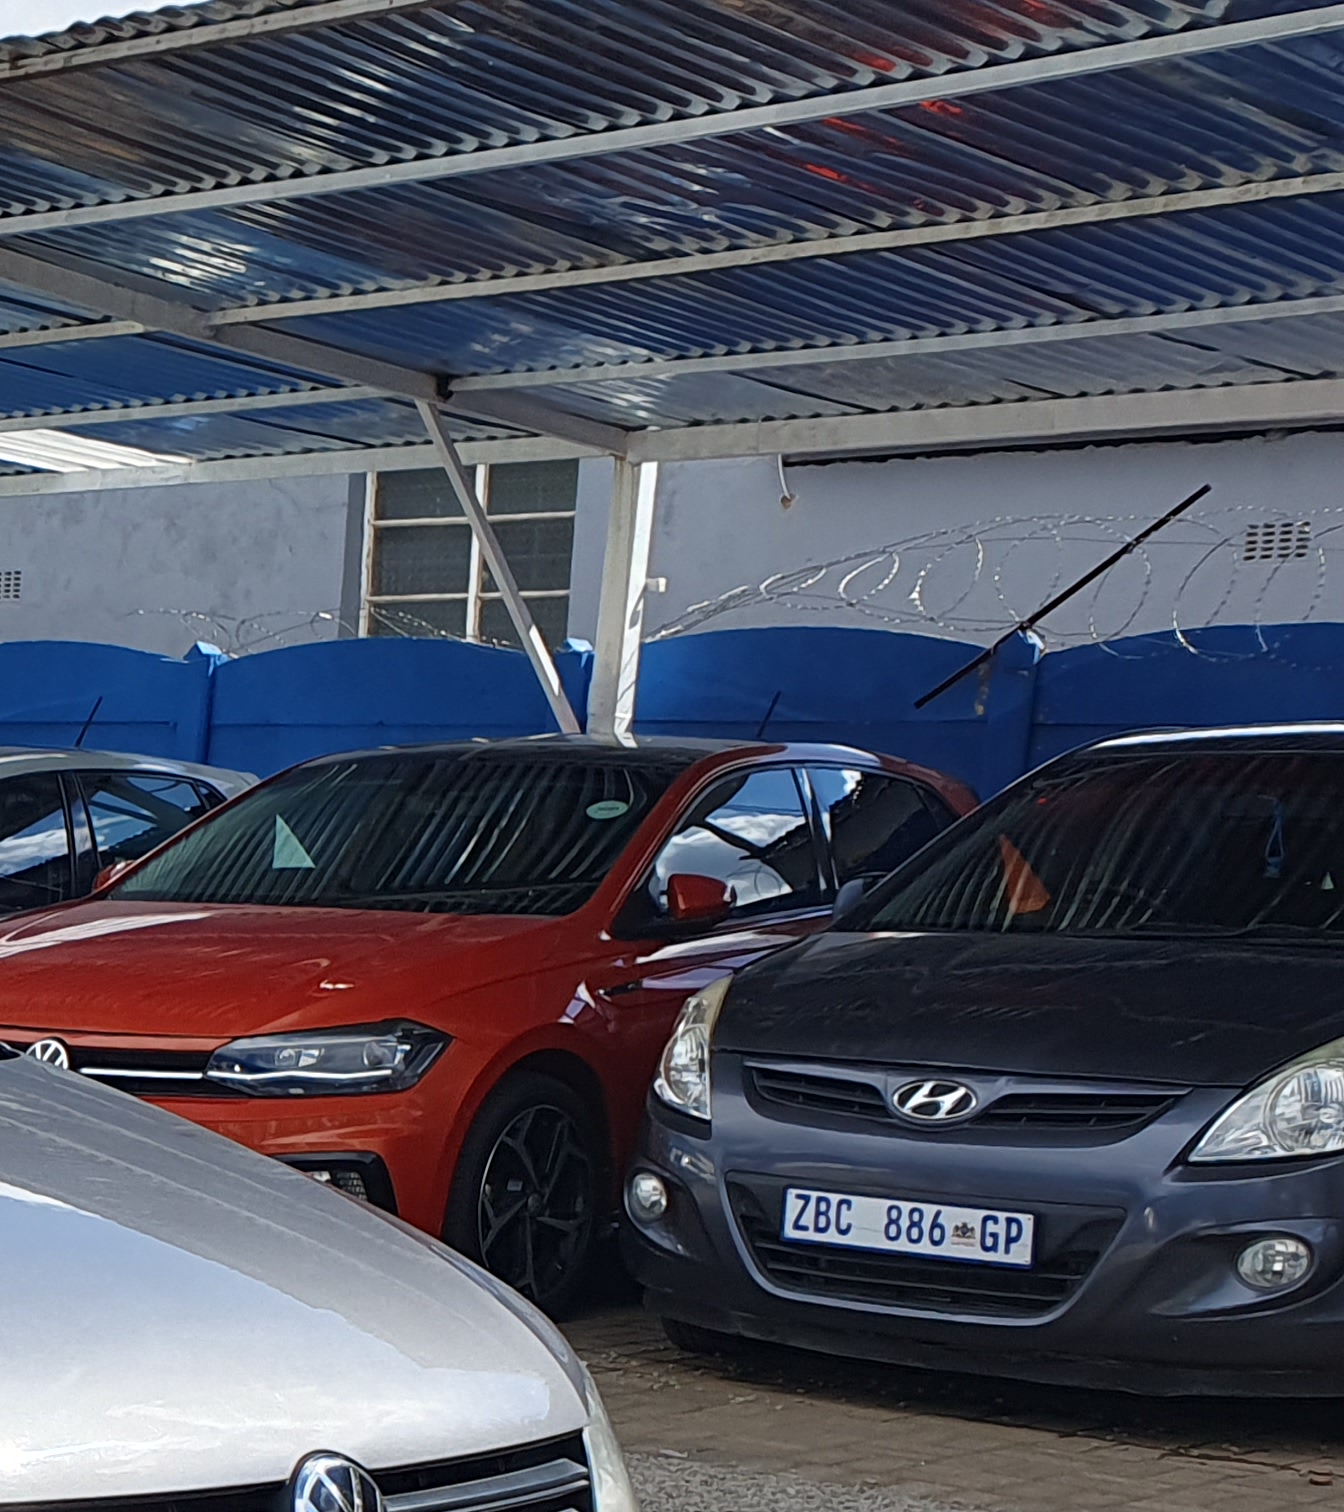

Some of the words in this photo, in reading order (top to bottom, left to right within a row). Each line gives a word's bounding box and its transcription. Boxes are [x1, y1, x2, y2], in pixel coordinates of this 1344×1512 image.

[791, 1193, 853, 1236] ZBC
[883, 1204, 946, 1247] 886
[979, 1214, 1024, 1255] GP
